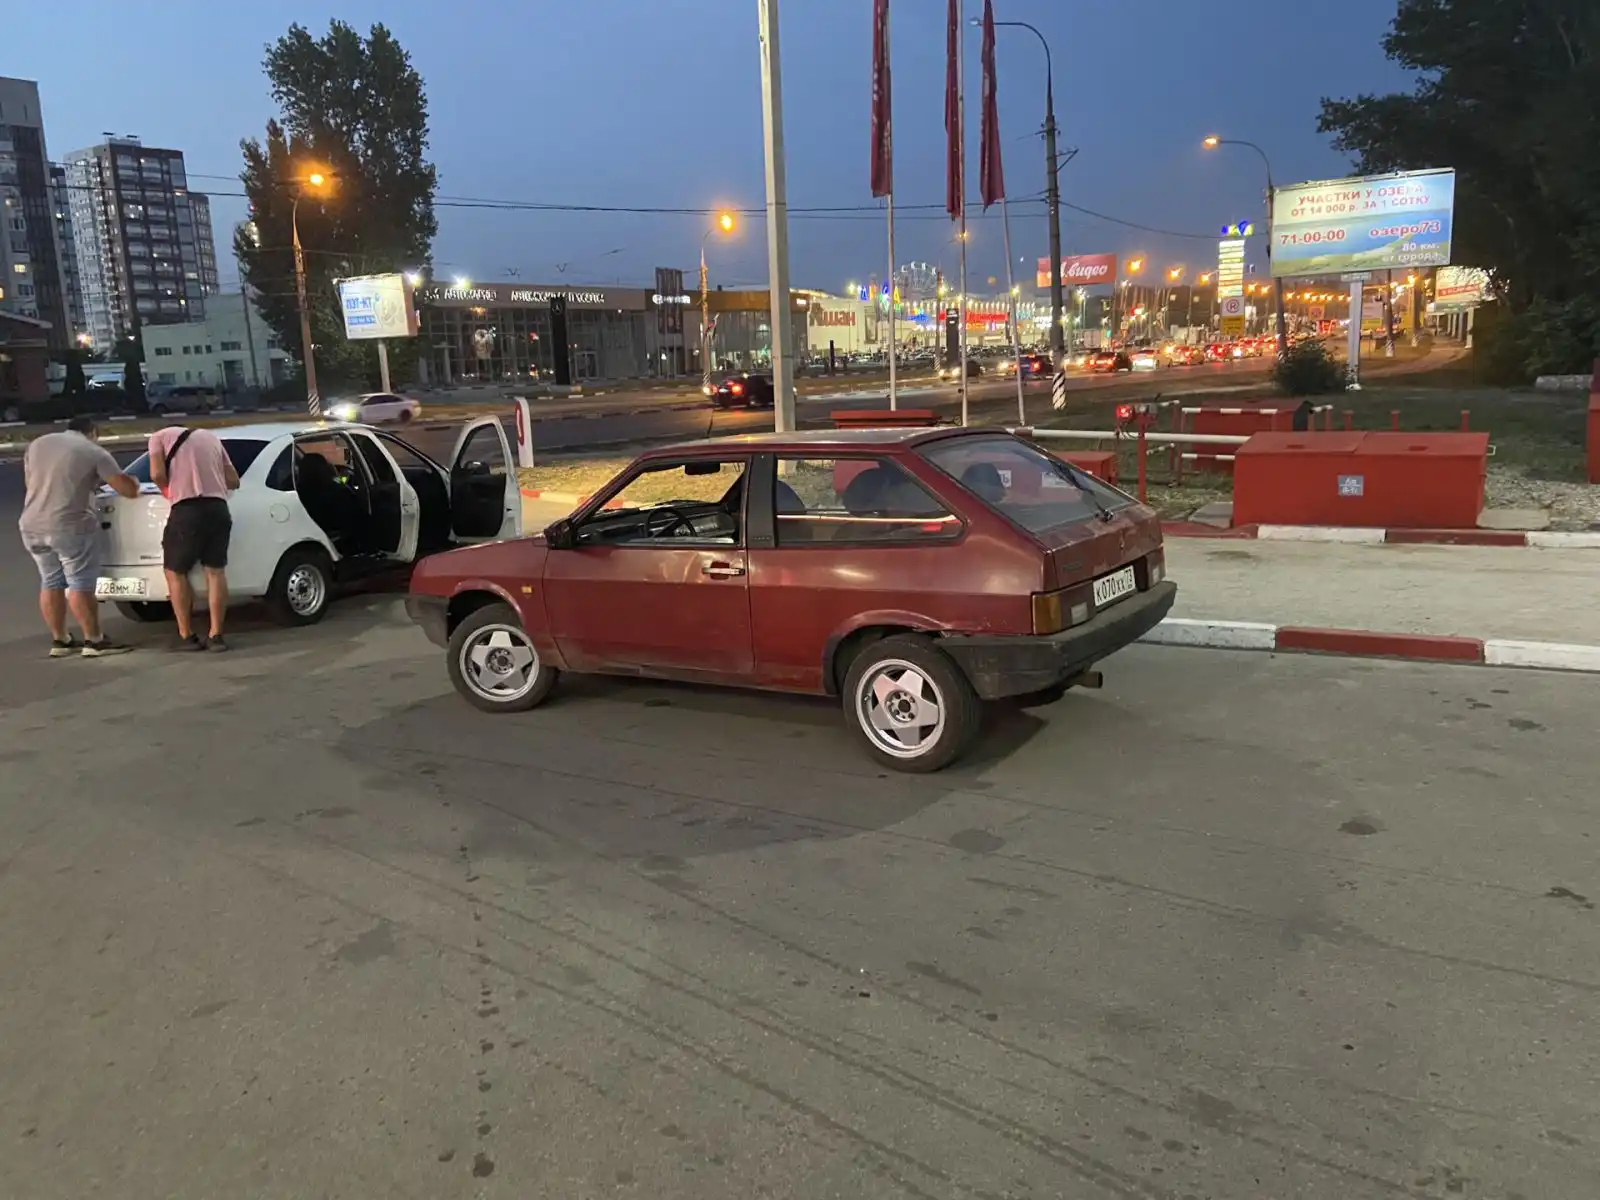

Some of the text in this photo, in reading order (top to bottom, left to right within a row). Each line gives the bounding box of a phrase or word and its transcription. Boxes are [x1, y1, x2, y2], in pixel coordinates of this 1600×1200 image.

[1299, 190, 1361, 206] УЧАСТКИ
[1365, 191, 1373, 199] У
[1291, 209, 1305, 217] ОТ
[1310, 207, 1322, 215] 14
[1326, 205, 1346, 213] 000
[1363, 201, 1377, 210] ЗА
[1392, 195, 1430, 206] СОТКУ
[1281, 230, 1345, 245] 71-00-00
[1403, 242, 1417, 251] 80
